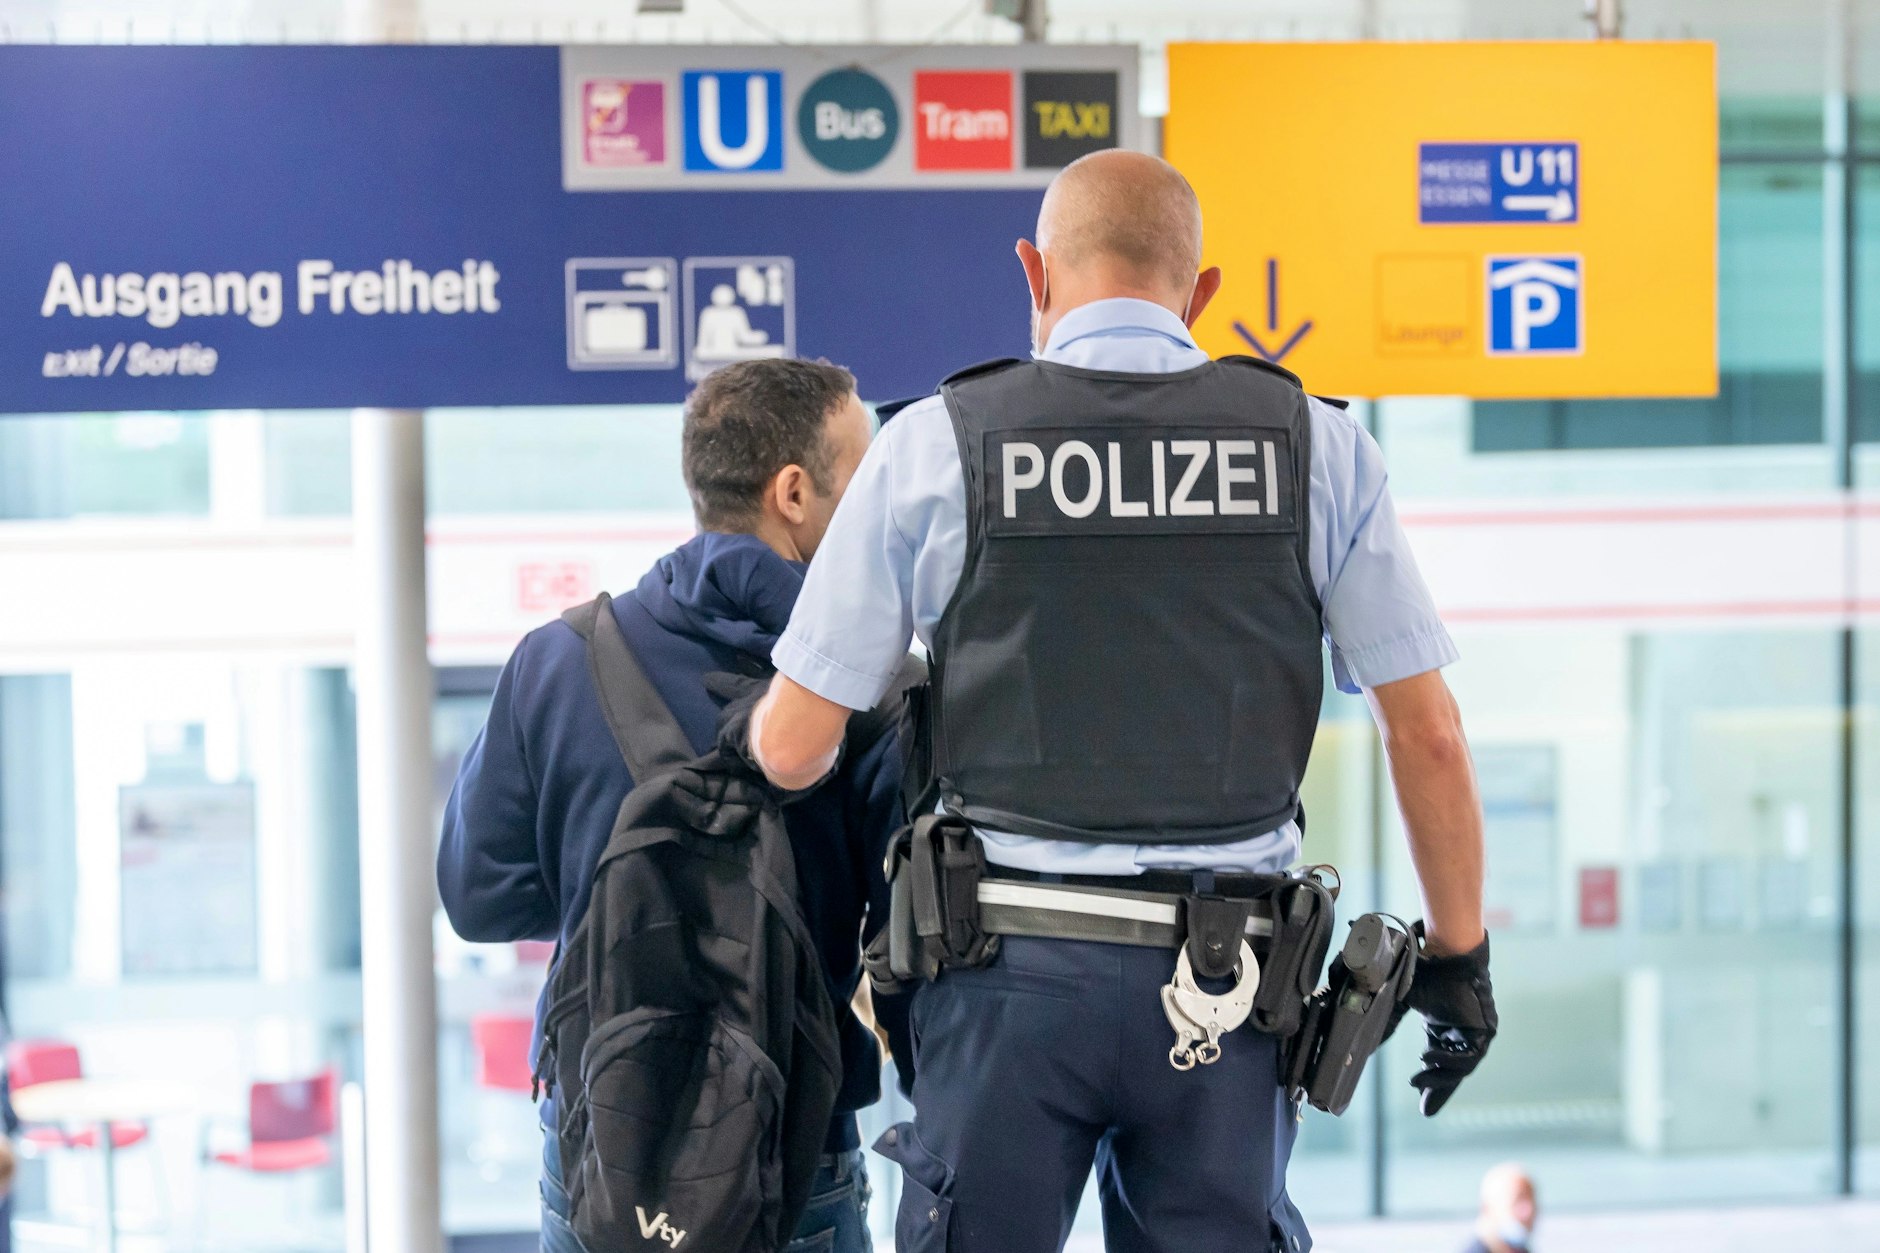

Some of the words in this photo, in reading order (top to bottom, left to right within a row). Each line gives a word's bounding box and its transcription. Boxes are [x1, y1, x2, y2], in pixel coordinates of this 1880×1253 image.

[698, 75, 769, 169] U
[815, 101, 887, 141] Bus
[919, 102, 1009, 141] Tram
[1034, 102, 1111, 139] TAXI
[41, 261, 283, 328] Ausgang
[297, 258, 501, 315] Freiheit
[1511, 281, 1562, 350] P
[125, 341, 219, 377] Sortie
[1002, 440, 1279, 519] POLIZEI
